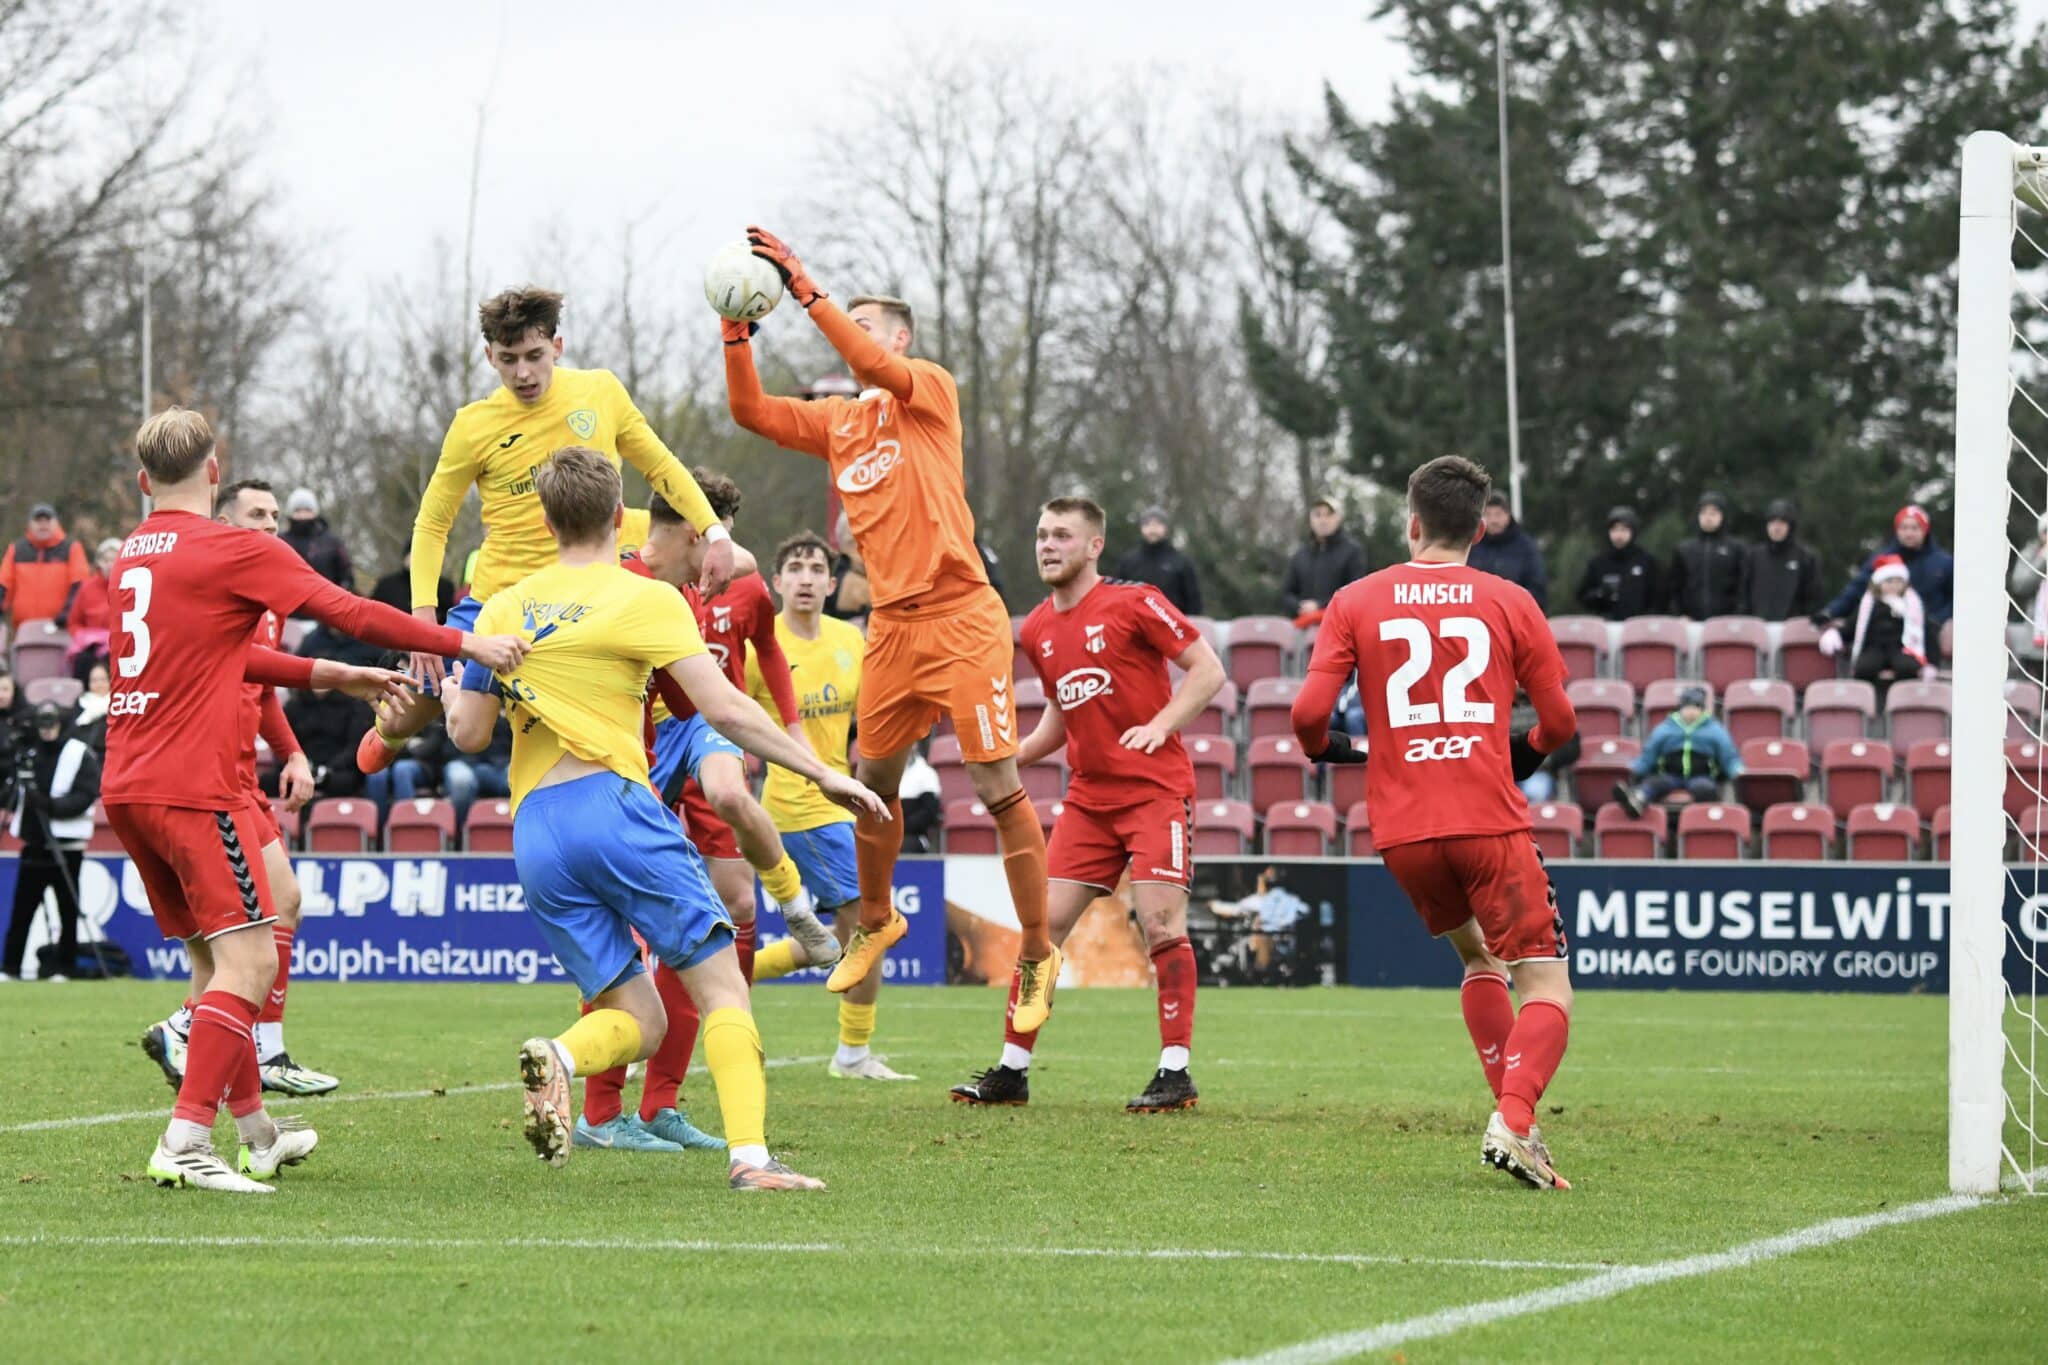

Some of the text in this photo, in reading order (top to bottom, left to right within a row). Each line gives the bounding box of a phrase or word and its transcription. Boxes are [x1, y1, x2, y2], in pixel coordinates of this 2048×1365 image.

[1394, 583, 1473, 605] HANSCH
[118, 566, 153, 678] 3
[1379, 616, 1496, 728] 22
[1404, 735, 1484, 763] acer
[1575, 948, 1939, 979] DIHAG FOUNDRY GROUP
